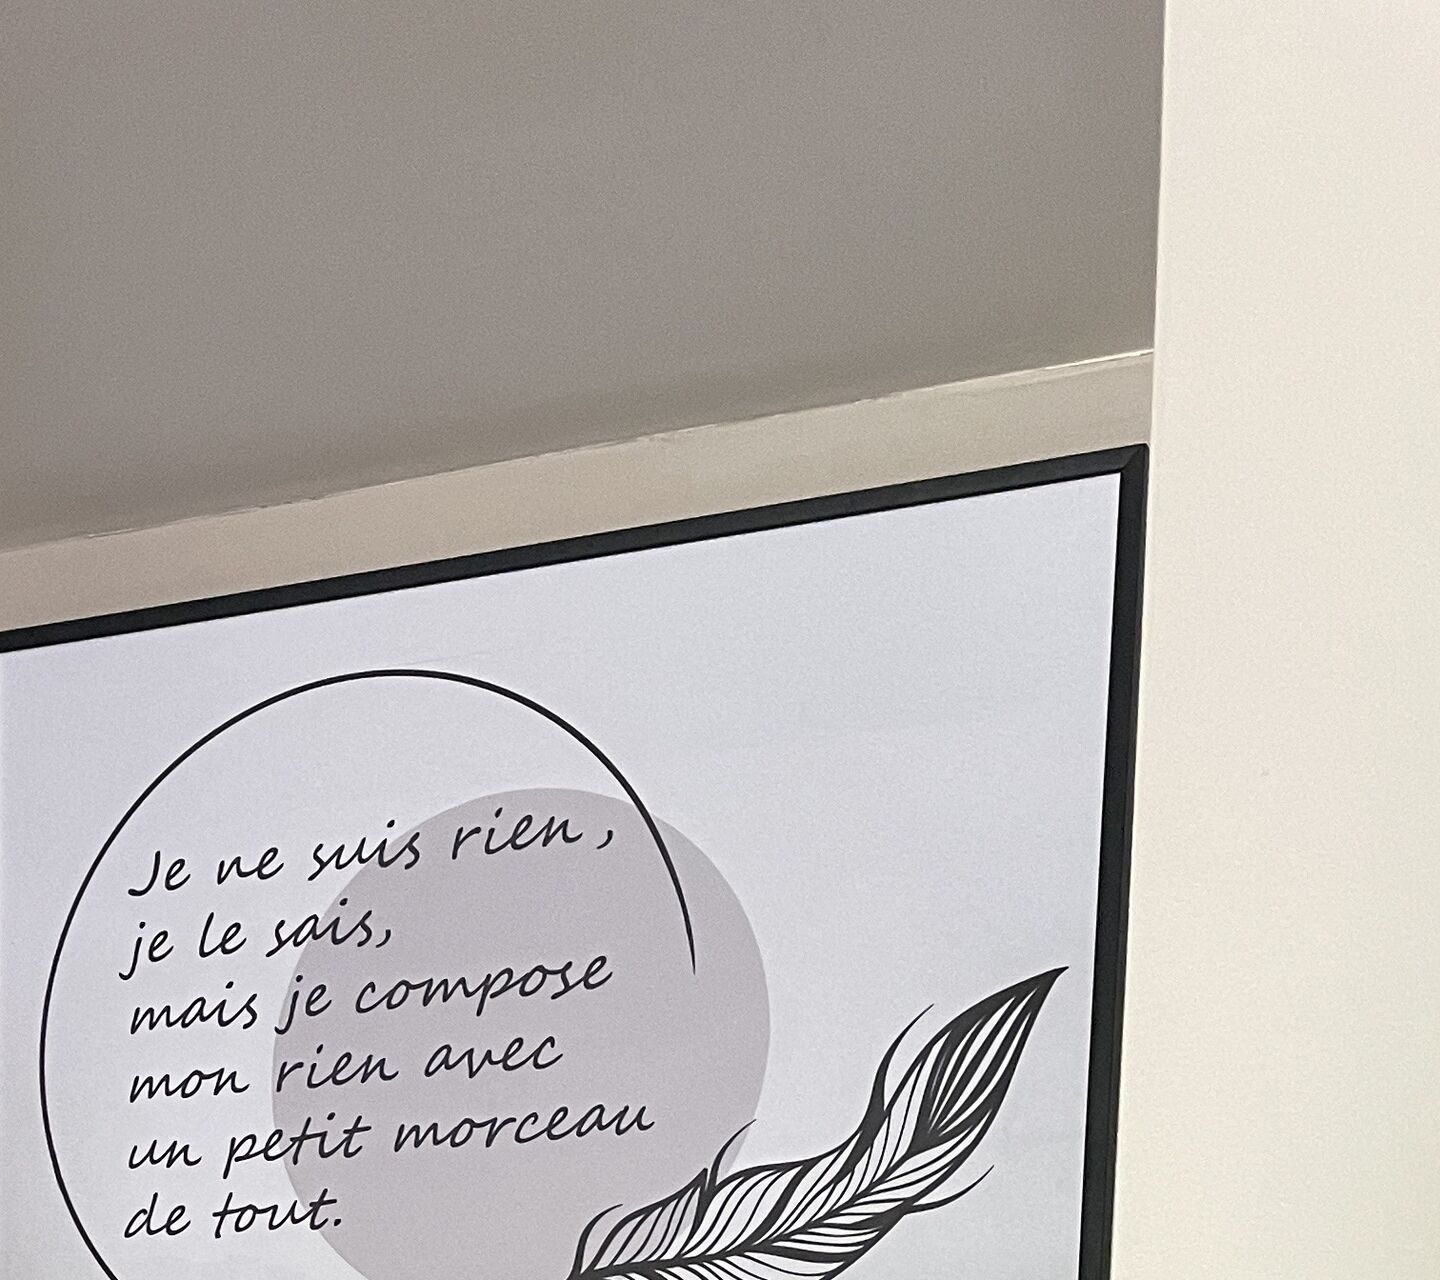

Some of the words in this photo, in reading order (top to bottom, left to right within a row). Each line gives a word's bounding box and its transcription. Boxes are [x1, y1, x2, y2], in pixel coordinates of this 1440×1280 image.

[128, 850, 191, 897] Je
[217, 846, 284, 886] ne
[307, 818, 421, 881] suis
[119, 921, 175, 980] je
[197, 911, 247, 959] le
[265, 898, 392, 958] sais,
[130, 981, 258, 1035] mais
[275, 974, 332, 1034] je
[355, 953, 612, 1016] compose
[129, 1067, 250, 1103] mon
[275, 1044, 398, 1093] rien
[424, 1035, 563, 1078] avec
[127, 1136, 202, 1170] un
[223, 1112, 373, 1178] petit
[392, 1102, 654, 1152] morceau
[124, 1192, 191, 1238] de
[213, 1188, 342, 1238] tout.
